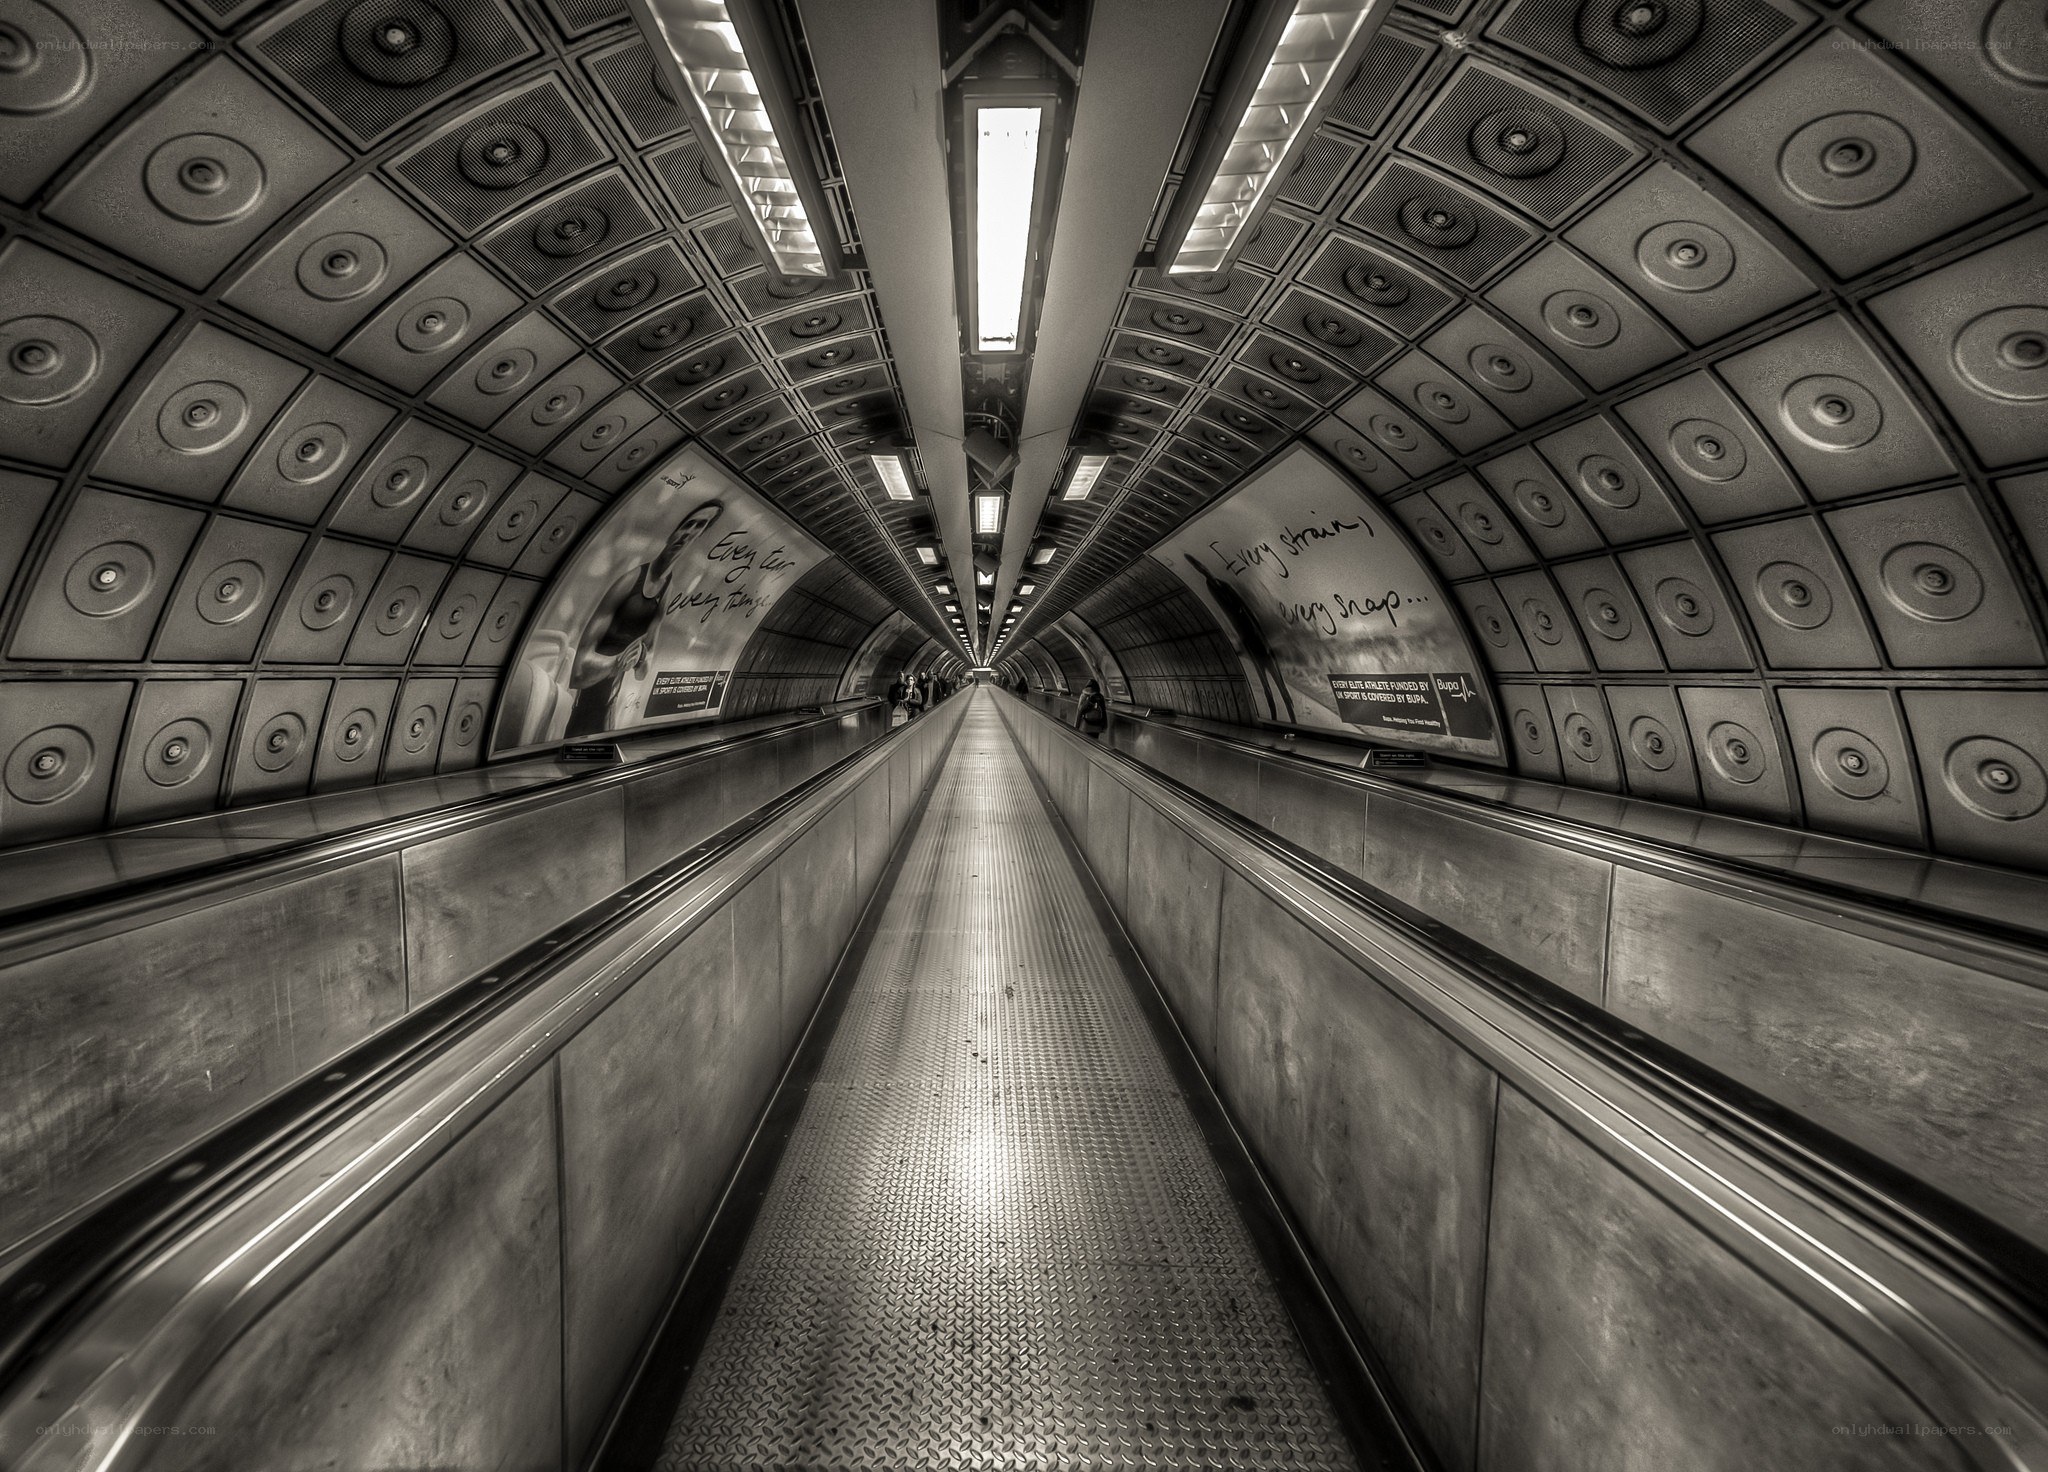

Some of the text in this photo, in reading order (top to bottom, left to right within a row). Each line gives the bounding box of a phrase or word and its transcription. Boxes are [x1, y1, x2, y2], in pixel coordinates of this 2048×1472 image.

[707, 530, 758, 584] Every
[1209, 510, 1375, 579] Every strain,
[666, 592, 720, 624] every
[1279, 600, 1337, 636] every
[1332, 681, 1429, 691] EVERY ELITE ATHLETE FUNDED BY
[1344, 692, 1361, 700] SPORT
[1360, 692, 1368, 701] IS
[1367, 692, 1396, 702] COVERED
[1395, 693, 1405, 703] BY
[1405, 693, 1429, 704] BUPA.
[1437, 679, 1460, 692] Bupa
